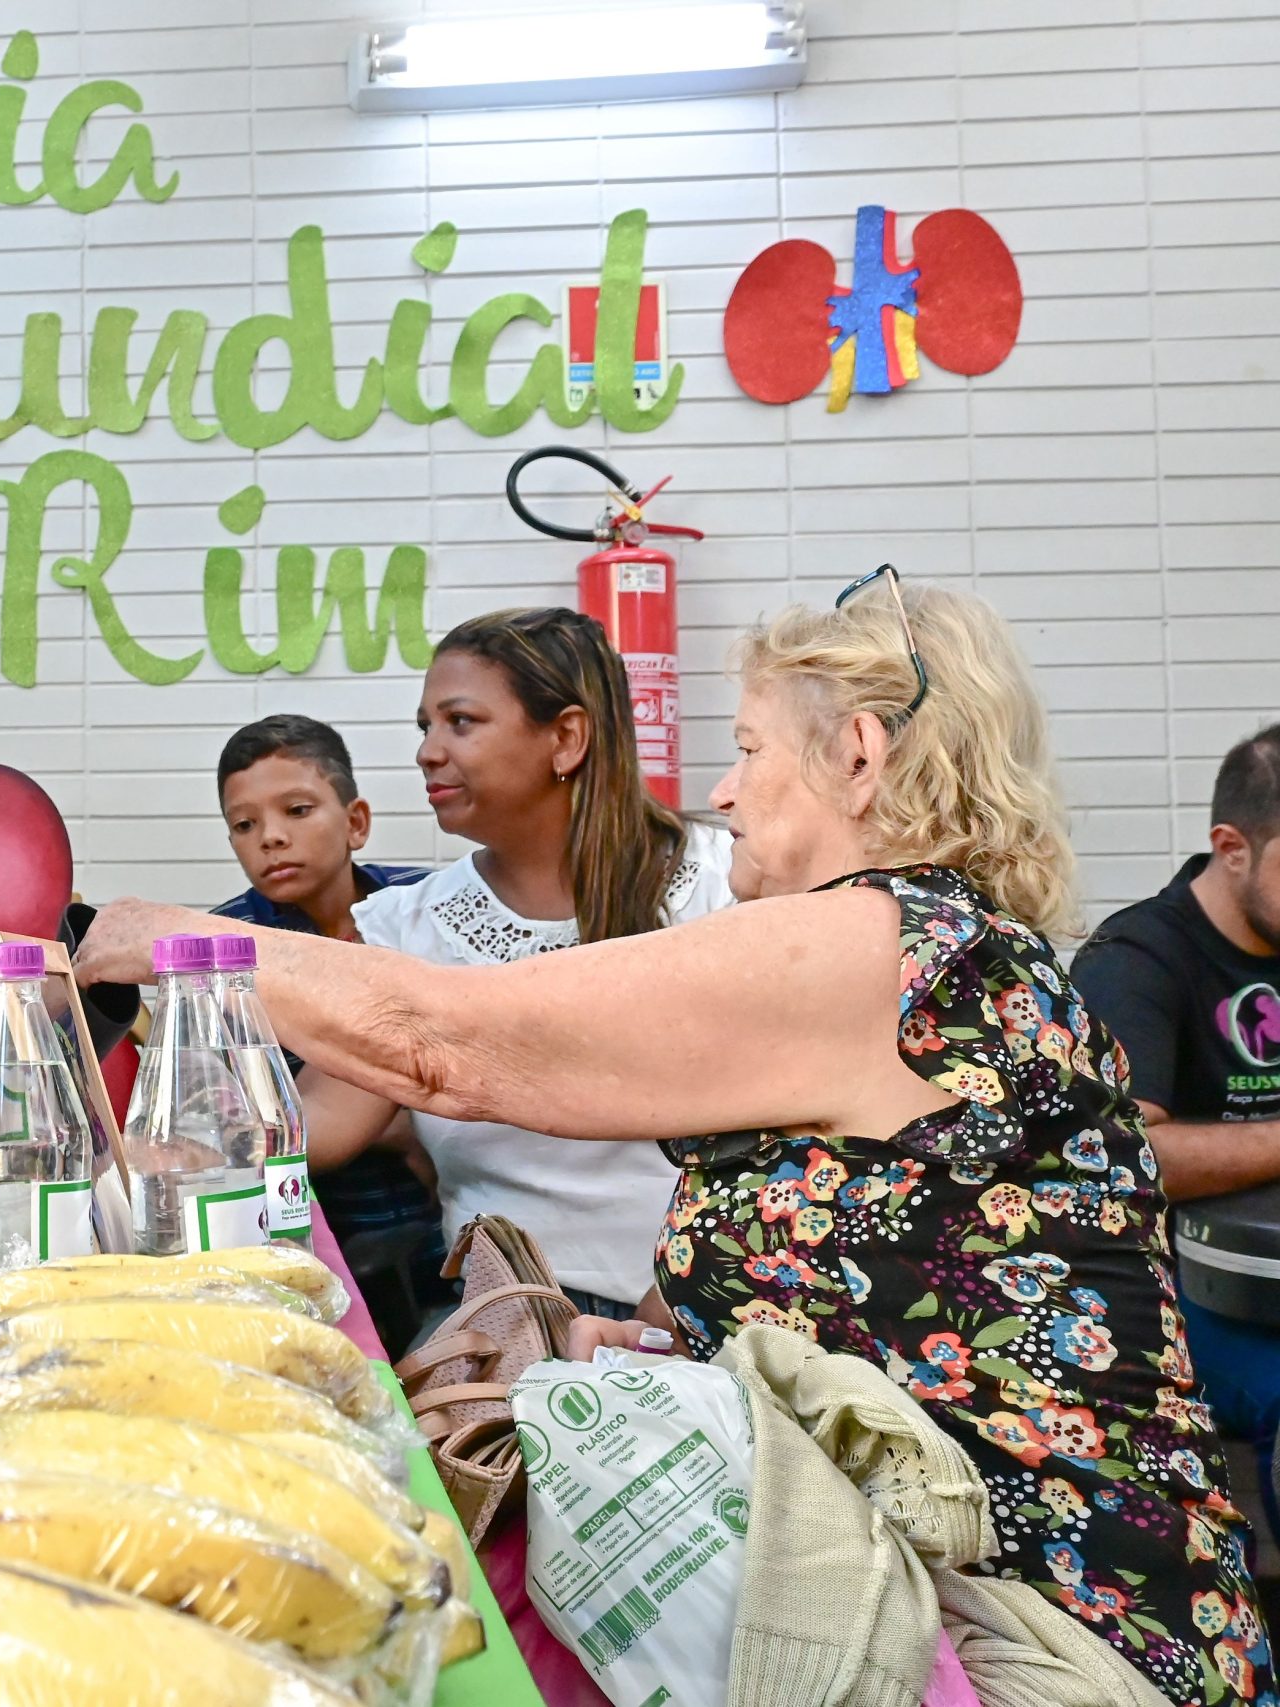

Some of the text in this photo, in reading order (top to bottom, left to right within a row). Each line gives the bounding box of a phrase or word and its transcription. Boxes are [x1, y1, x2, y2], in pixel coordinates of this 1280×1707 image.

[1227, 1075, 1271, 1090] SEUS
[635, 1381, 670, 1408] VIDRO
[576, 1413, 628, 1455] PLÁSTICO
[668, 1439, 697, 1463] VIDRO
[533, 1463, 569, 1493] PAPEL
[551, 1475, 571, 1494] Jornais
[556, 1482, 579, 1504] Revistas
[582, 1509, 614, 1535] PAPEL
[545, 1550, 564, 1567] Comida
[642, 1521, 716, 1585] MATERIAL 100%
[652, 1537, 729, 1603] BIODEGRADÁVEL
[632, 1613, 661, 1639] 100002
